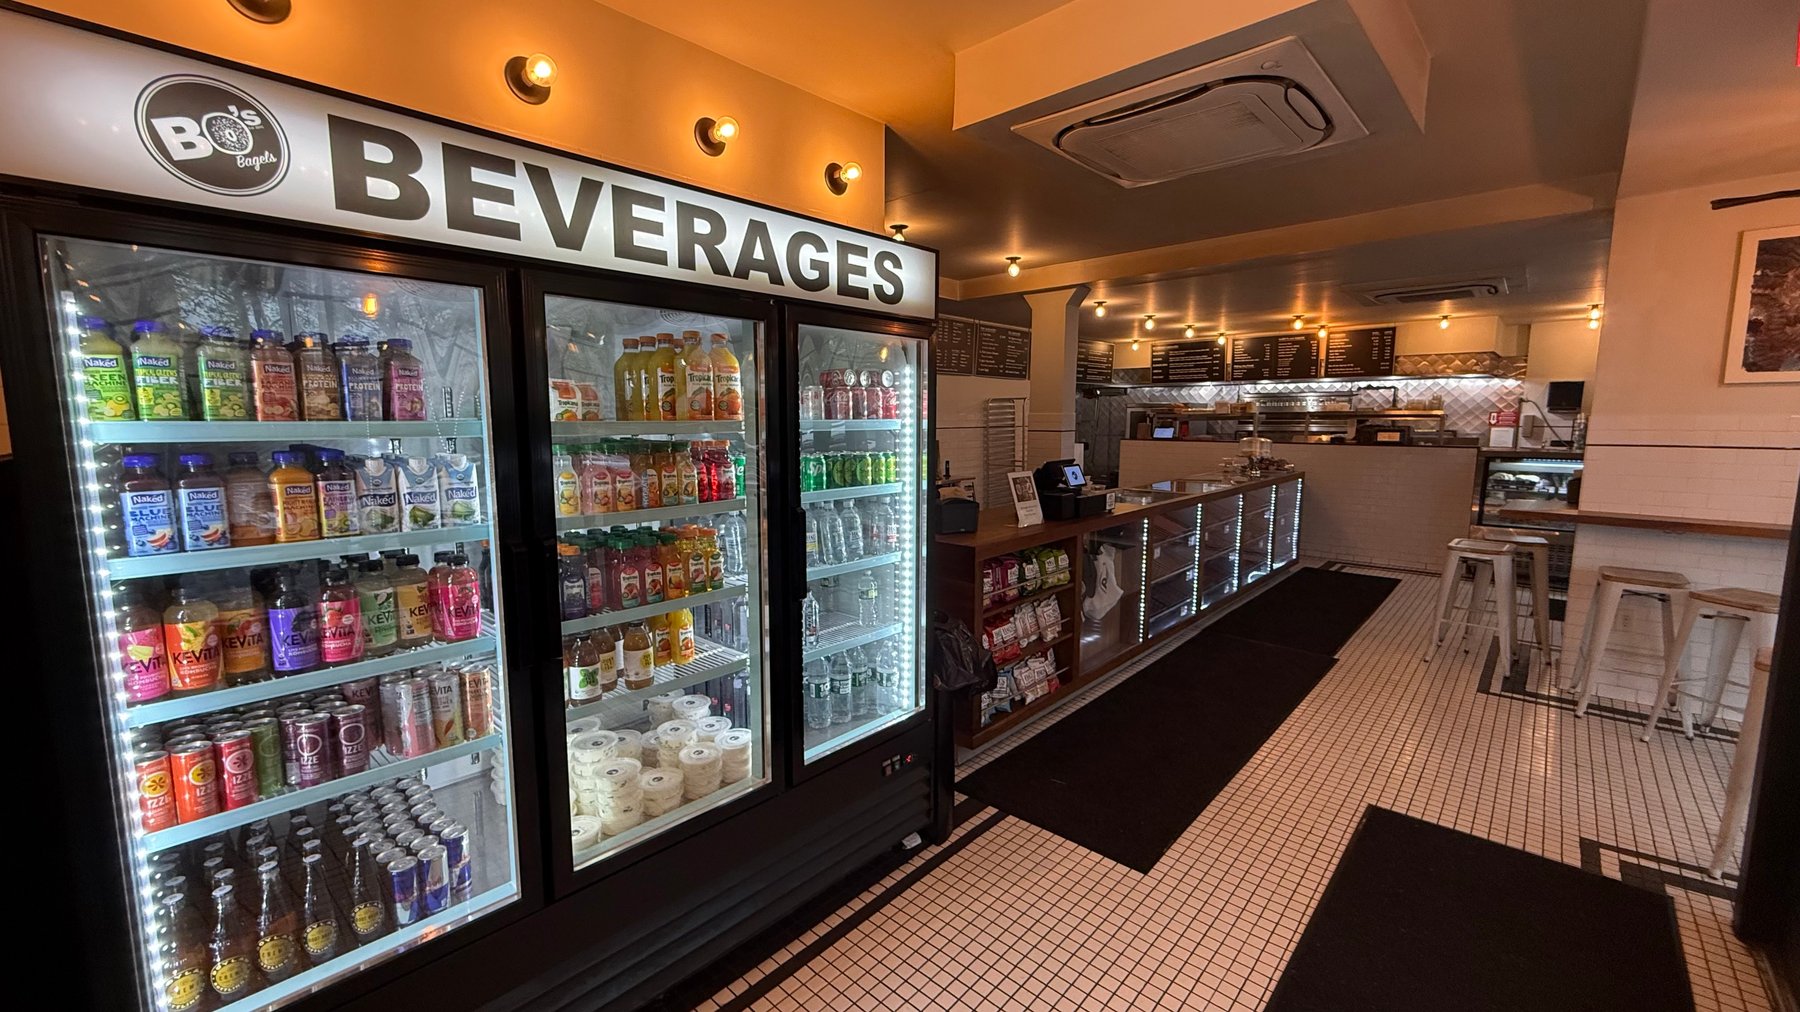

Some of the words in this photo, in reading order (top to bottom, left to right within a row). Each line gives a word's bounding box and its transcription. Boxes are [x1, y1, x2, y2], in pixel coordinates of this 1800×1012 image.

[235, 151, 277, 172] Bagels
[327, 113, 904, 305] BEVERAGES
[84, 359, 117, 367] Naked
[138, 356, 169, 366] Naked
[207, 360, 235, 369] Naked
[265, 365, 290, 374] Naked
[688, 372, 712, 383] Tropica
[715, 374, 739, 384] Tropica
[349, 382, 381, 391] PROTEIN
[286, 486, 311, 495] Naked
[326, 483, 350, 491] Naked
[132, 493, 163, 504] Naked
[189, 491, 218, 500] Naked
[405, 493, 437, 505] Naked
[447, 489, 477, 499] Naked
[362, 495, 395, 506] Naked
